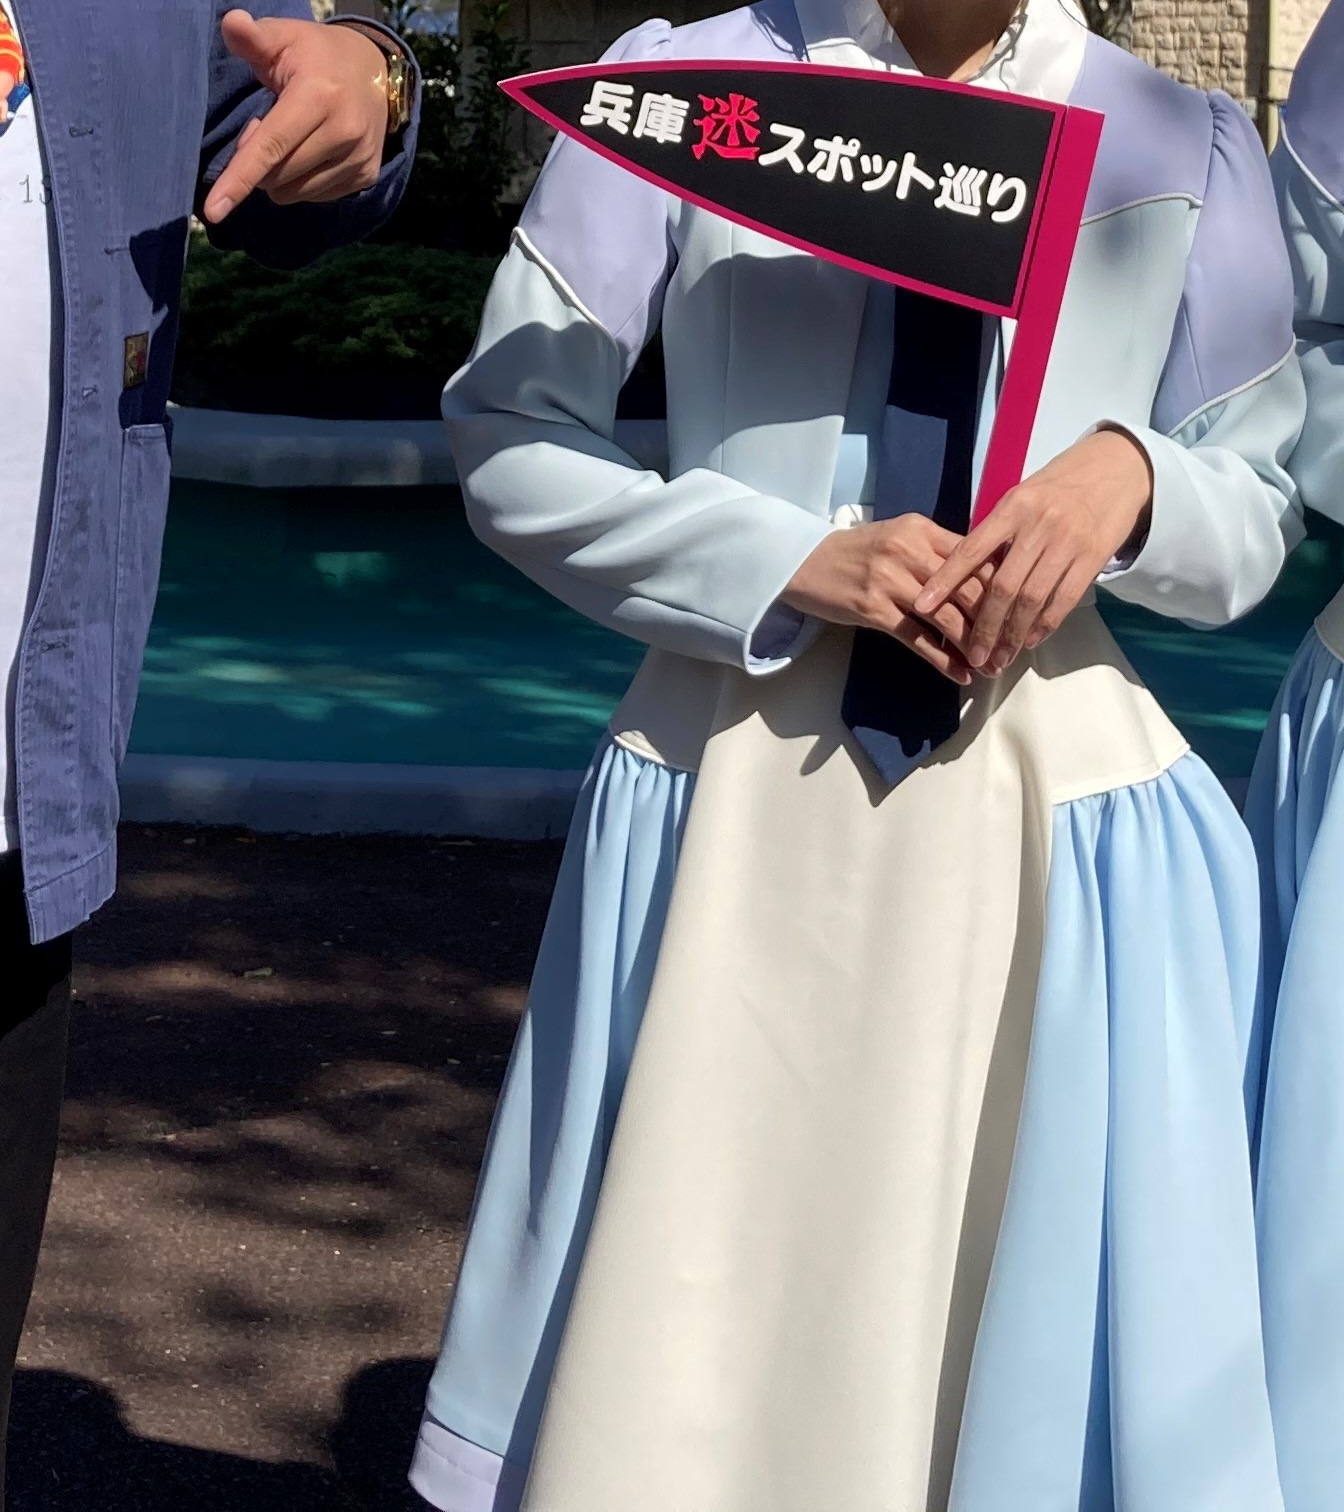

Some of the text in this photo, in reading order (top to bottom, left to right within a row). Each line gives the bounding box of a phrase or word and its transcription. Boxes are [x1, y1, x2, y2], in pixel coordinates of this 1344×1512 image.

[580, 80, 1027, 223] 兵庫迷スポット巡り
